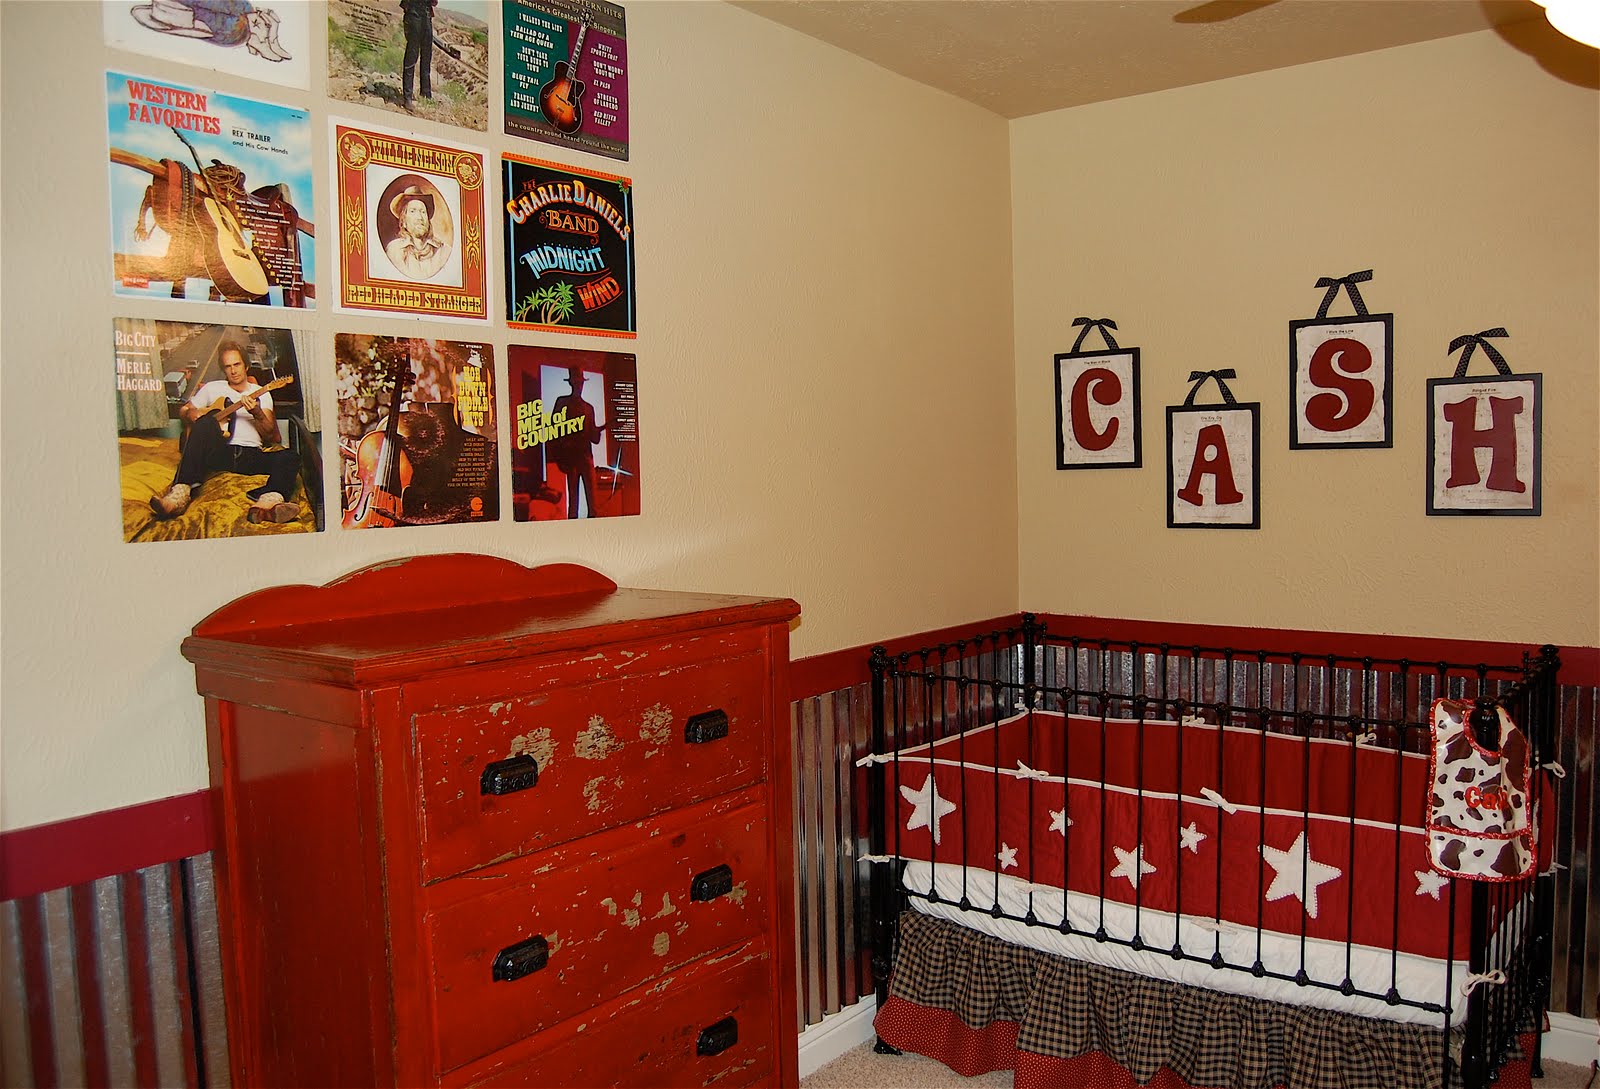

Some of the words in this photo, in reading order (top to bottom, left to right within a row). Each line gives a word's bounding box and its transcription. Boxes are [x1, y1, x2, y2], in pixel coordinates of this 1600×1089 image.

[603, 5, 623, 20] HITS
[510, 29, 524, 41] TEEN
[524, 34, 536, 44] AGE
[536, 38, 554, 50] QUEEN
[515, 24, 537, 38] BALLAD
[537, 32, 545, 41] OF
[511, 71, 526, 82] BLUE
[526, 76, 540, 86] TAIL
[519, 80, 530, 90] FLY
[127, 79, 207, 113] WESTERN
[596, 92, 618, 104] STREETS
[128, 102, 222, 136] FAVORITES
[232, 129, 244, 138] REX
[247, 132, 272, 143] TRAILER
[232, 140, 244, 148] and
[256, 143, 269, 151] Cow
[270, 146, 289, 155] Hands
[508, 121, 519, 129] the
[519, 124, 543, 135] country
[544, 129, 562, 139] sound
[563, 134, 580, 143] heard
[600, 142, 610, 150] the
[610, 145, 626, 154] world
[371, 139, 413, 166] WILLIE
[414, 147, 456, 173] NELSON
[523, 178, 536, 191] THE
[506, 181, 573, 225] CHARLIE
[573, 179, 632, 241] DANIELS
[546, 209, 600, 235] BAND
[520, 244, 606, 280] MIDNIGHT
[347, 285, 373, 302] RED
[374, 288, 422, 307] HEADED
[424, 292, 482, 312] STRANGER
[576, 276, 622, 310] WIND
[115, 330, 134, 347] BIG
[134, 331, 156, 347] CITY
[117, 358, 152, 375] MERLE
[117, 375, 162, 391] HAGGARD
[459, 381, 487, 397] DOWN
[1304, 337, 1376, 432] S
[463, 411, 484, 427] HITS
[516, 398, 543, 421] BIG
[517, 409, 552, 437] MEN
[552, 406, 568, 425] of
[1071, 367, 1123, 452] C
[516, 414, 587, 451] COUNTRY
[1442, 395, 1527, 494] H
[1177, 423, 1245, 508] A
